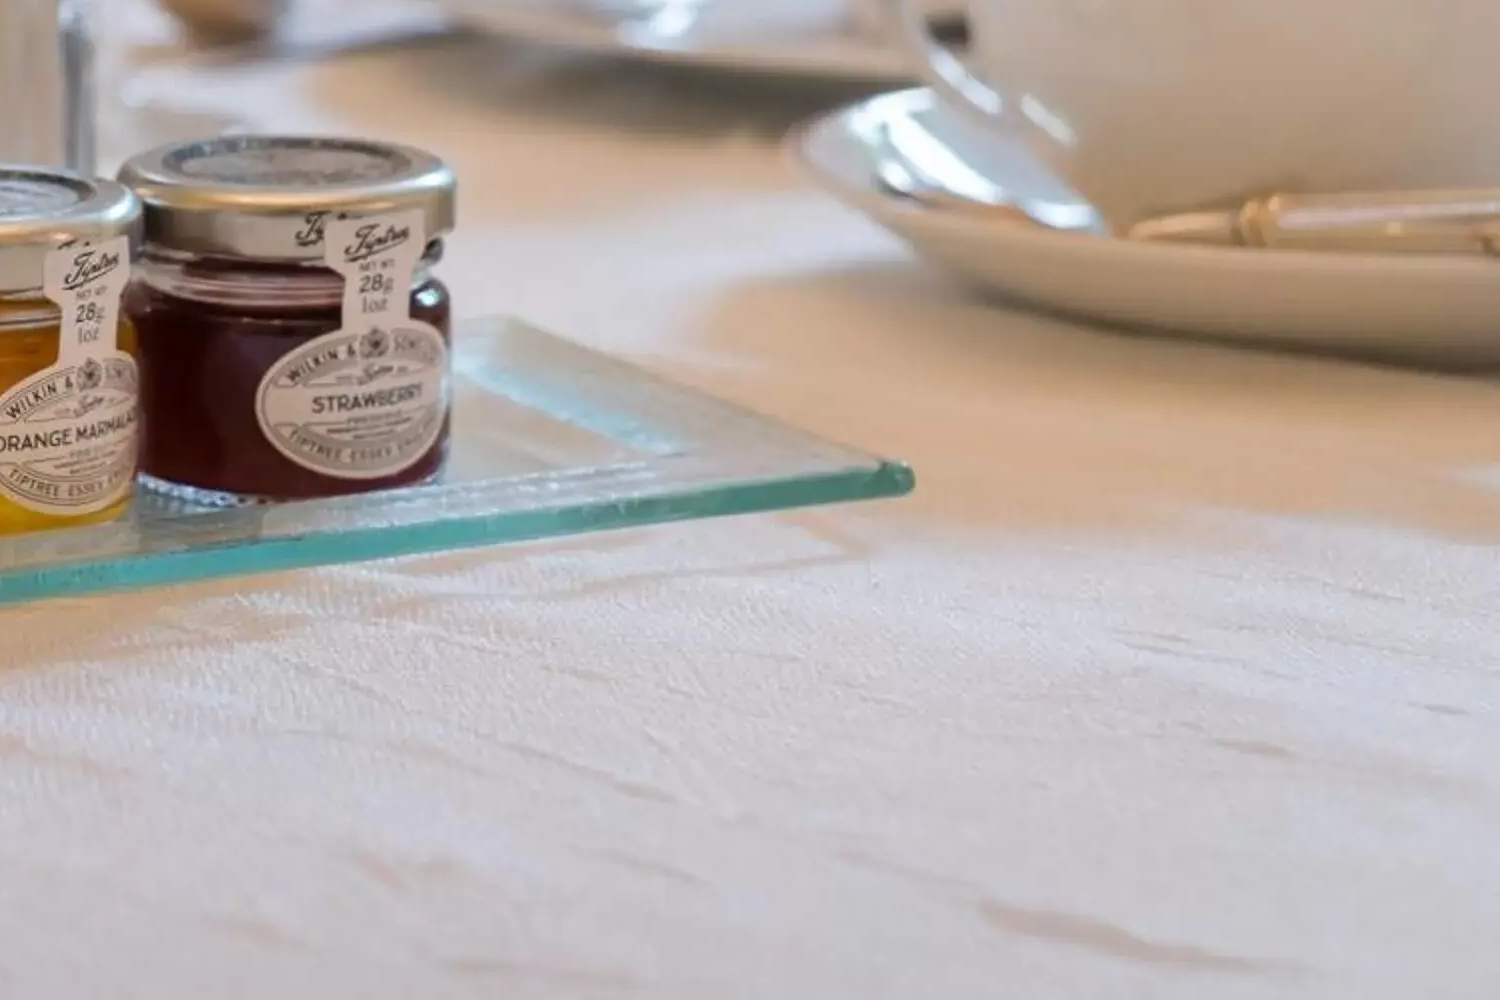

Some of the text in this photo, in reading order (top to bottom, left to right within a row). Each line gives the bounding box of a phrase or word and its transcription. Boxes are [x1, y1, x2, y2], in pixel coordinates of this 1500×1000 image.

[5, 381, 57, 418] WILKIN
[311, 383, 422, 414] STRAWBERRY
[9, 469, 60, 497] TIPTREE
